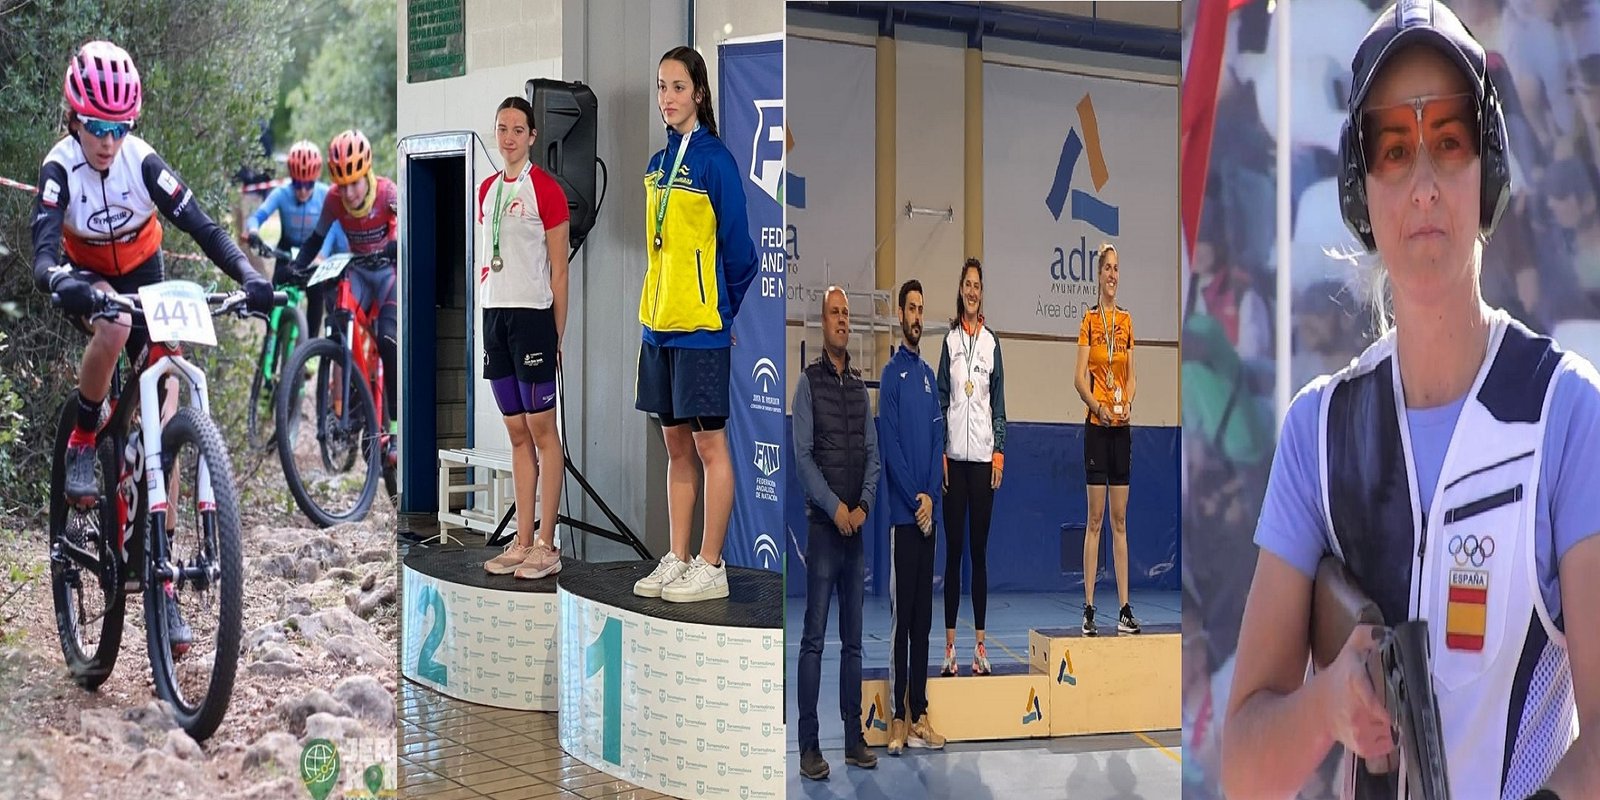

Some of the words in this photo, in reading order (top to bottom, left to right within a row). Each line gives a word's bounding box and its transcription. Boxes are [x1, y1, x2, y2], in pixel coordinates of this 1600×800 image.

[761, 227, 784, 249] FED
[761, 252, 784, 274] AND
[761, 276, 776, 298] DE
[153, 300, 203, 329] 441
[1063, 301, 1078, 319] de
[1452, 573, 1485, 585] ESPAÑA
[417, 585, 448, 687] 2
[586, 616, 622, 767] 1
